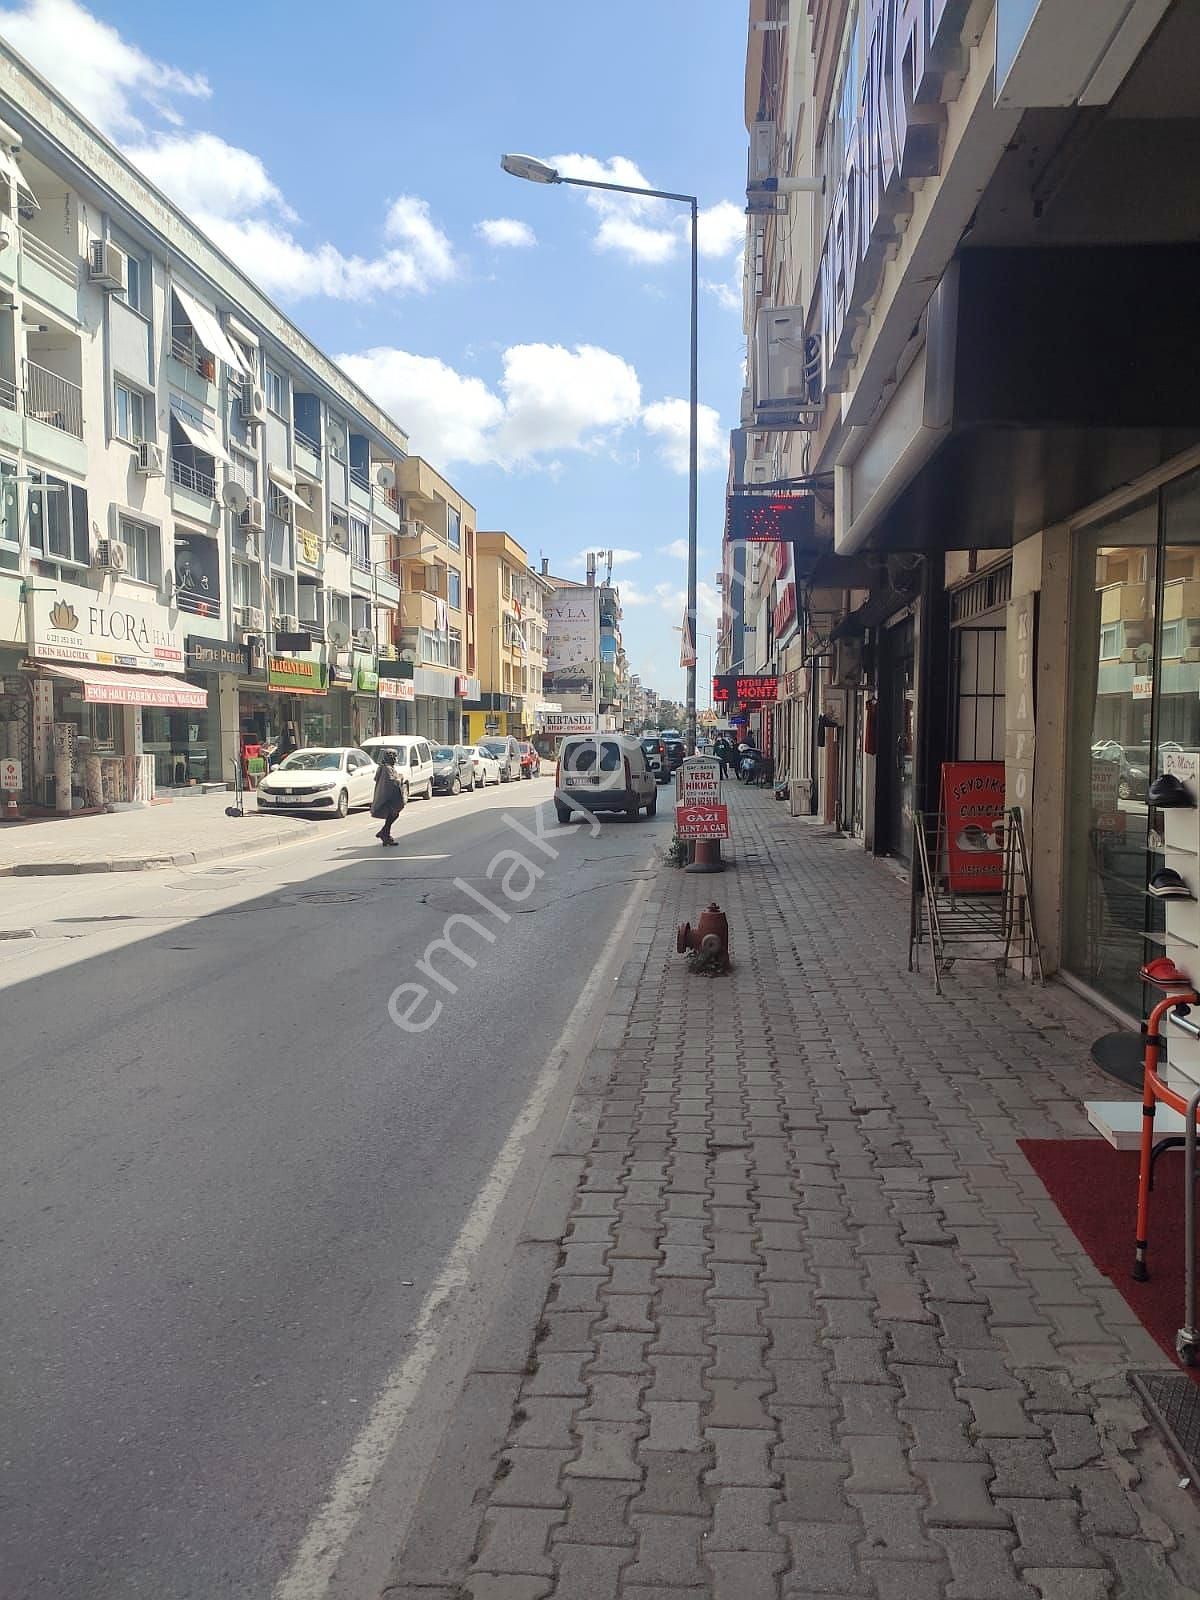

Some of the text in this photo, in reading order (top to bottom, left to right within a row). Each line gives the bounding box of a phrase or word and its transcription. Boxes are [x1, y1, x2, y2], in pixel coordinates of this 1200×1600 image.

[821, 0, 948, 392] MEDİKA
[88, 606, 150, 654] FLORA
[38, 646, 55, 656] EKİN
[680, 823, 726, 833] RENT A CAR
